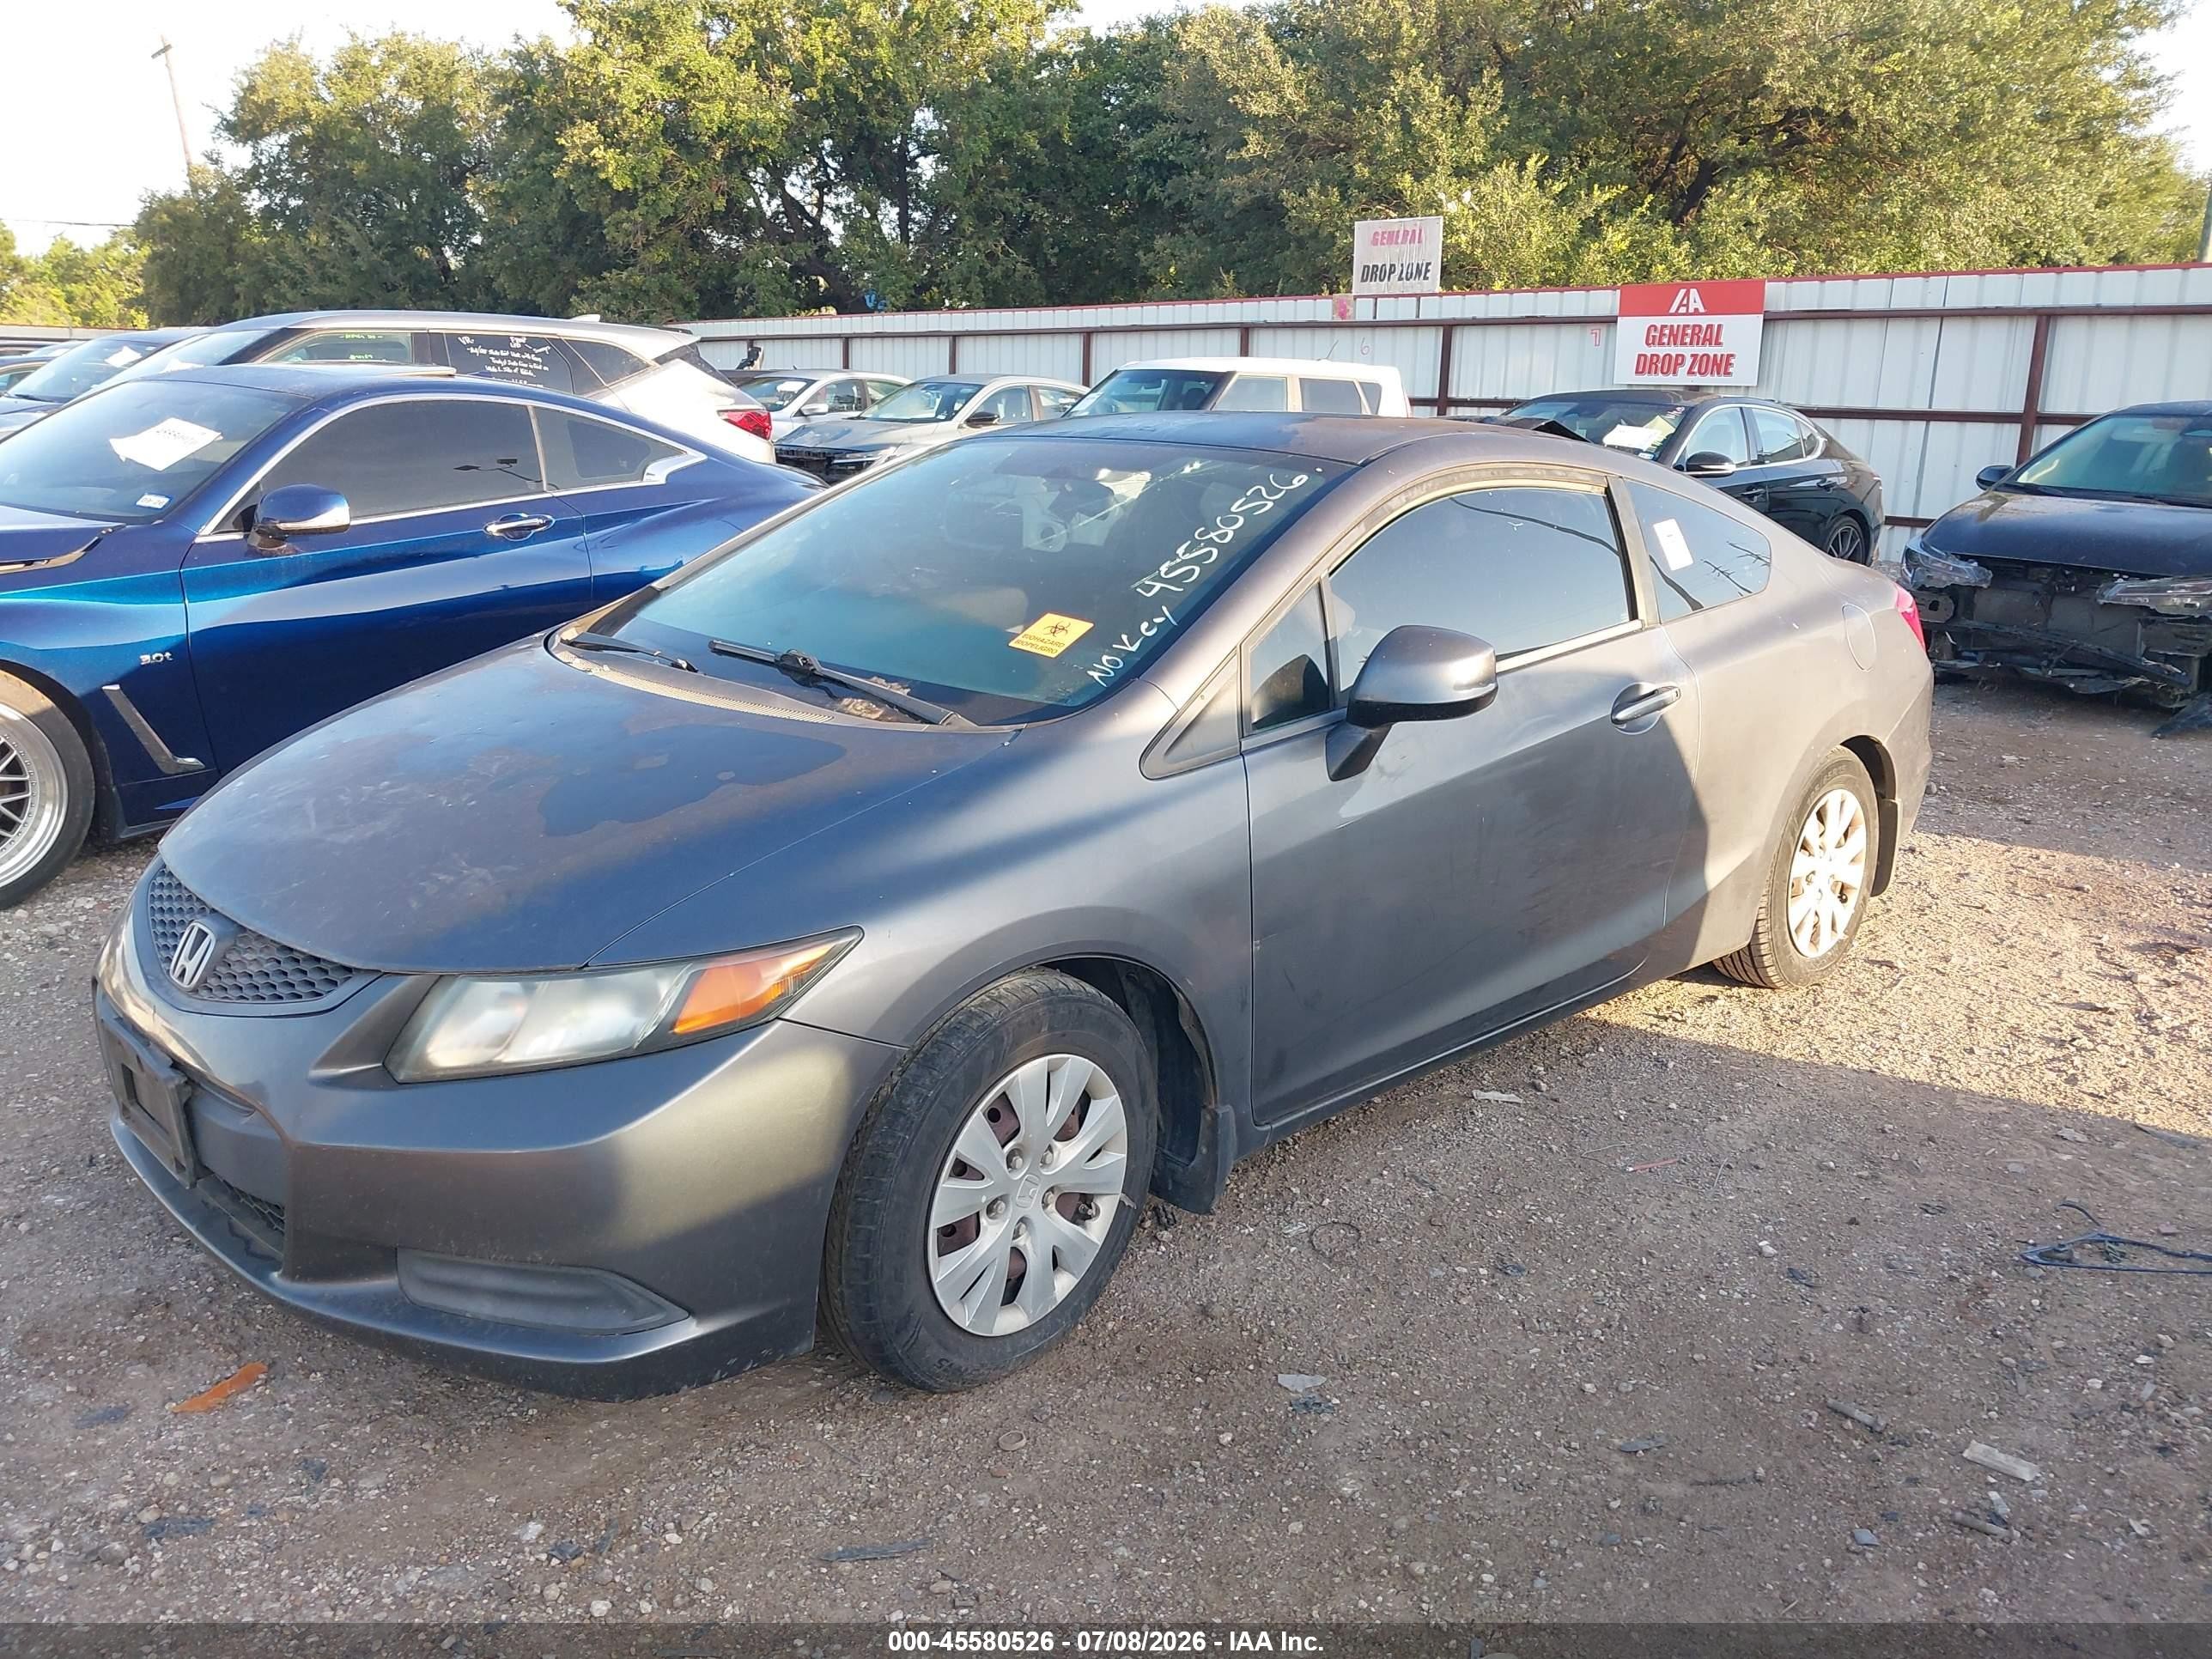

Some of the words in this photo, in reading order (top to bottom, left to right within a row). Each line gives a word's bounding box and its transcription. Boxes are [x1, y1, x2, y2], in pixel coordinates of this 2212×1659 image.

[1371, 228, 1424, 246] GENERAL
[1360, 264, 1396, 283] DROP
[1397, 262, 1431, 282] ZONE
[1644, 323, 1724, 348] GENERAL
[1360, 337, 1370, 356] 6
[1635, 353, 1686, 377] DROP
[1687, 353, 1736, 377] ZONE
[1136, 473, 1310, 598] 45580526
[1022, 634, 1066, 648] BIOHAZARD
